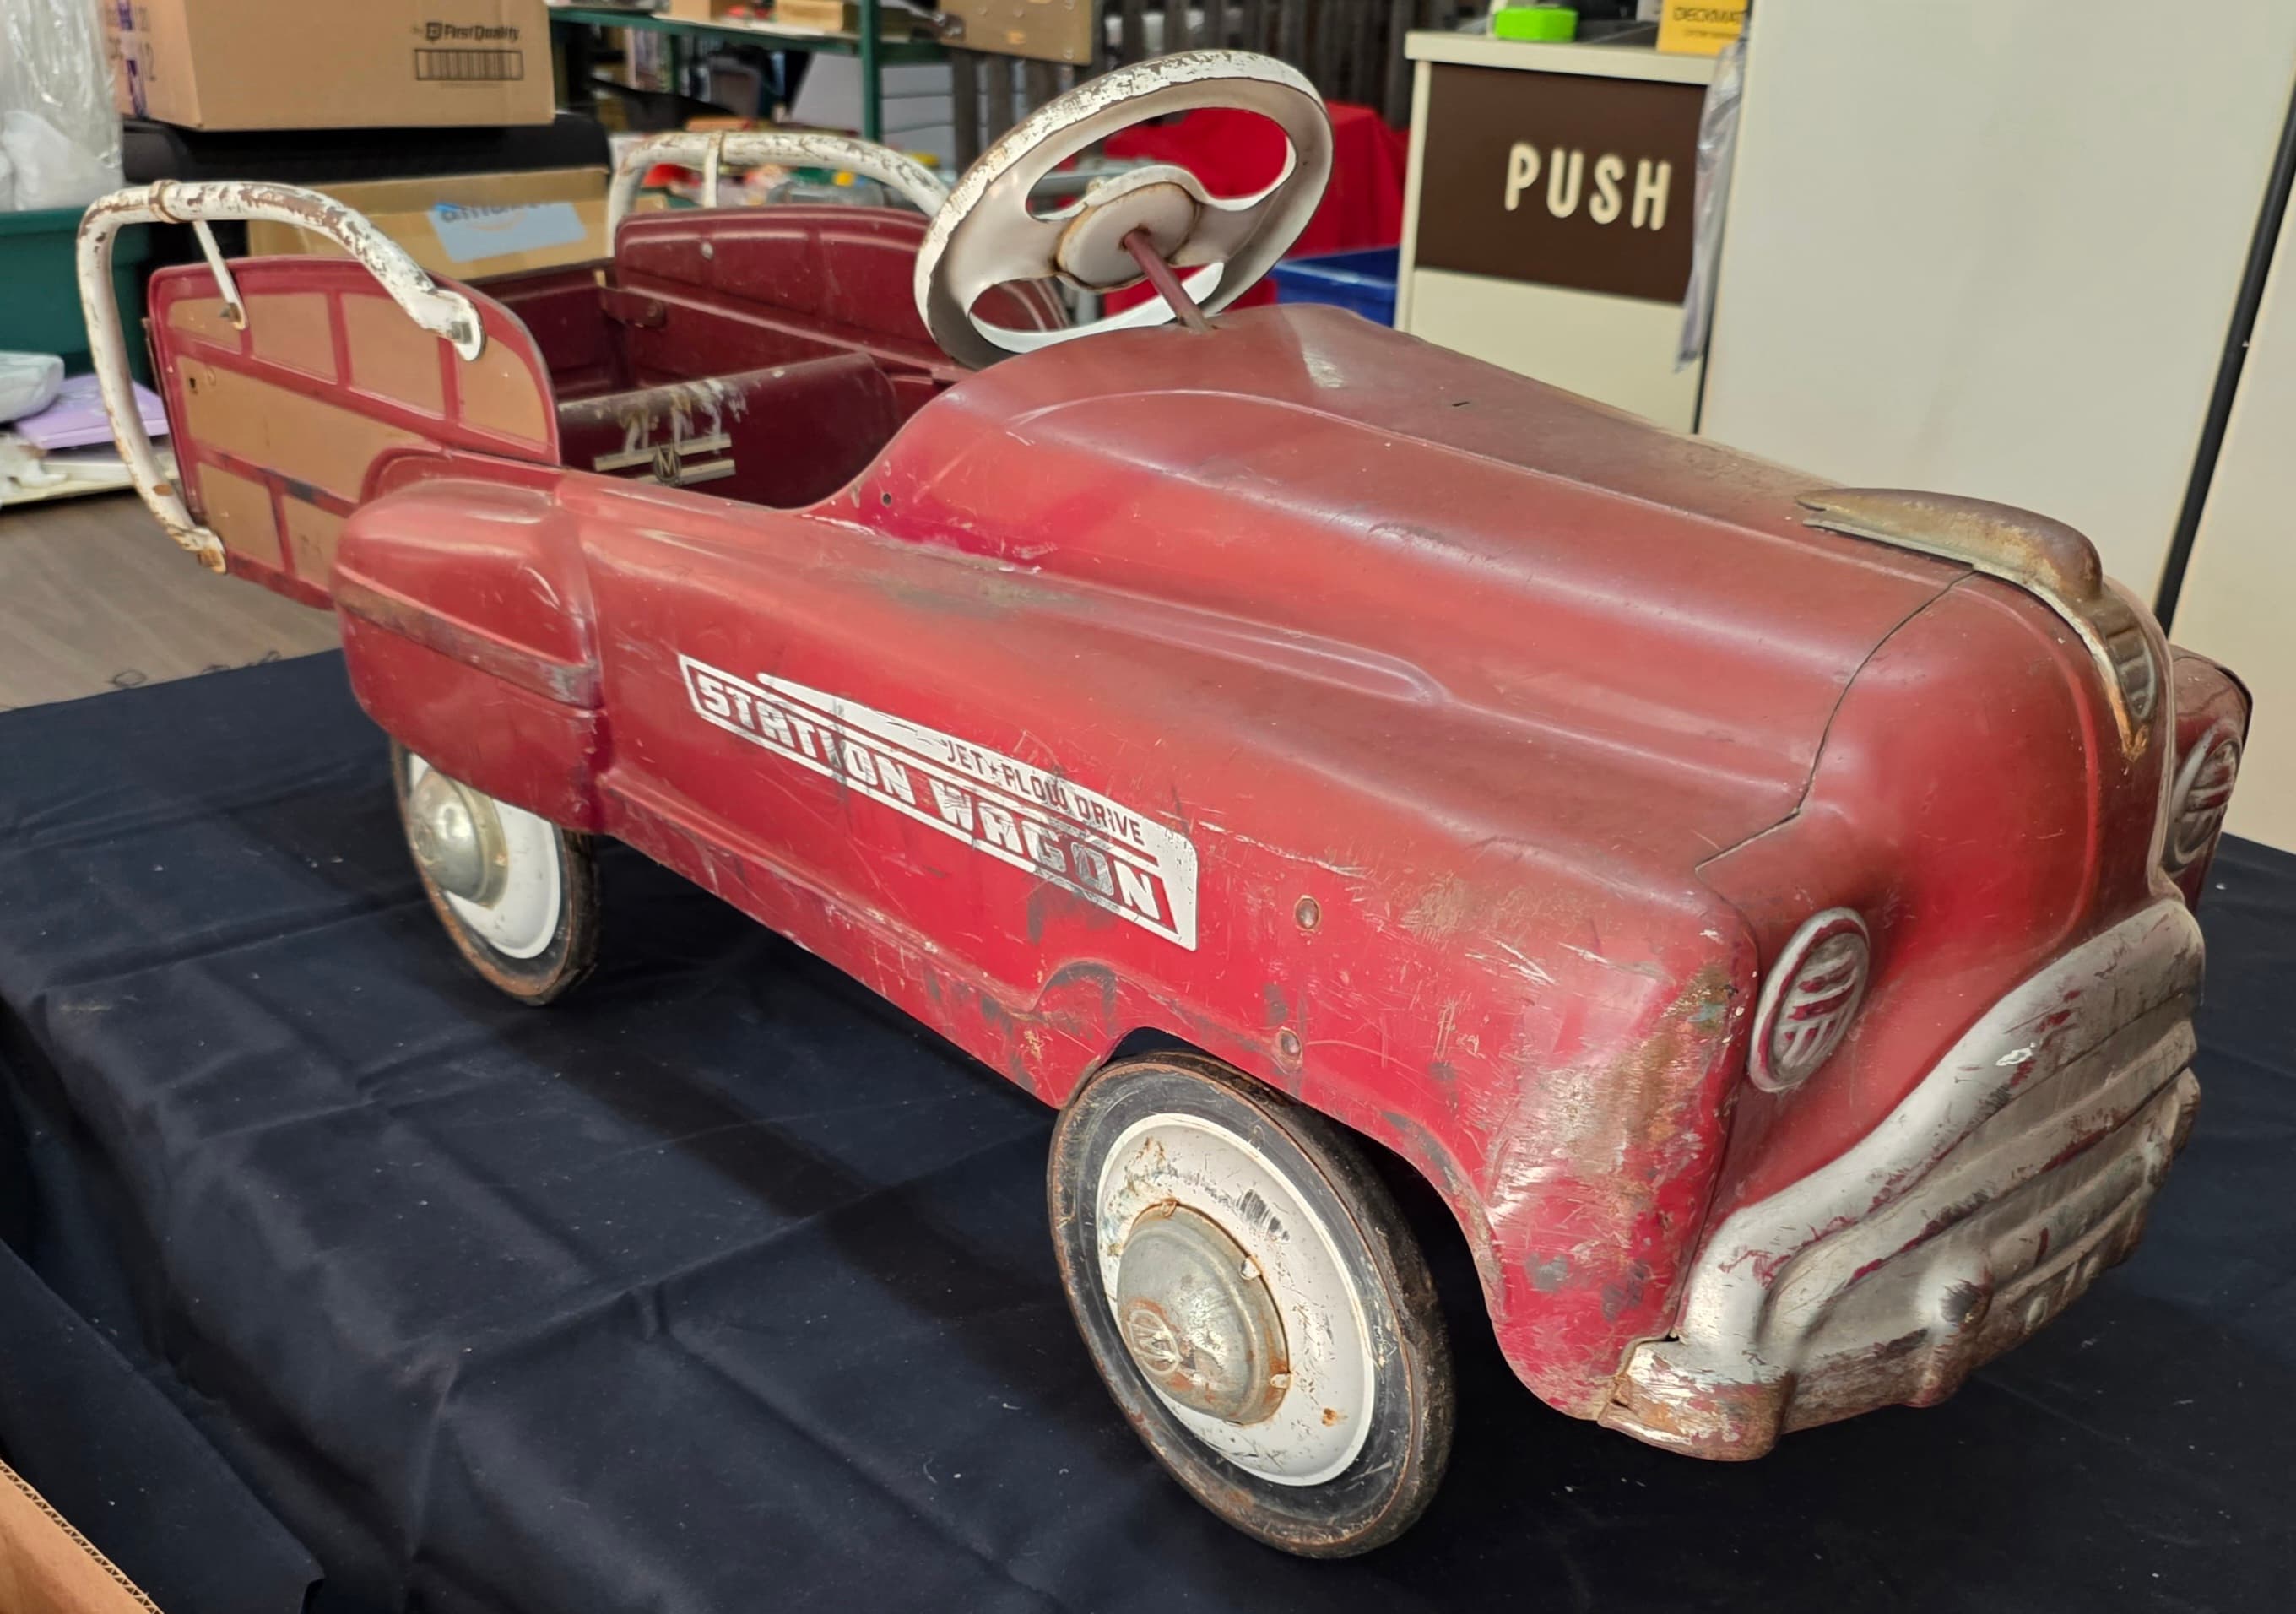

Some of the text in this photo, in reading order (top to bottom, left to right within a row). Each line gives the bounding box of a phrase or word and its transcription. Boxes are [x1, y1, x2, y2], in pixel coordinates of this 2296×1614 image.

[1504, 142, 1671, 231] PUSH
[697, 674, 1160, 920] STATION WAGON
[946, 740, 986, 774] JET
[1075, 795, 1145, 845] DRIVE
